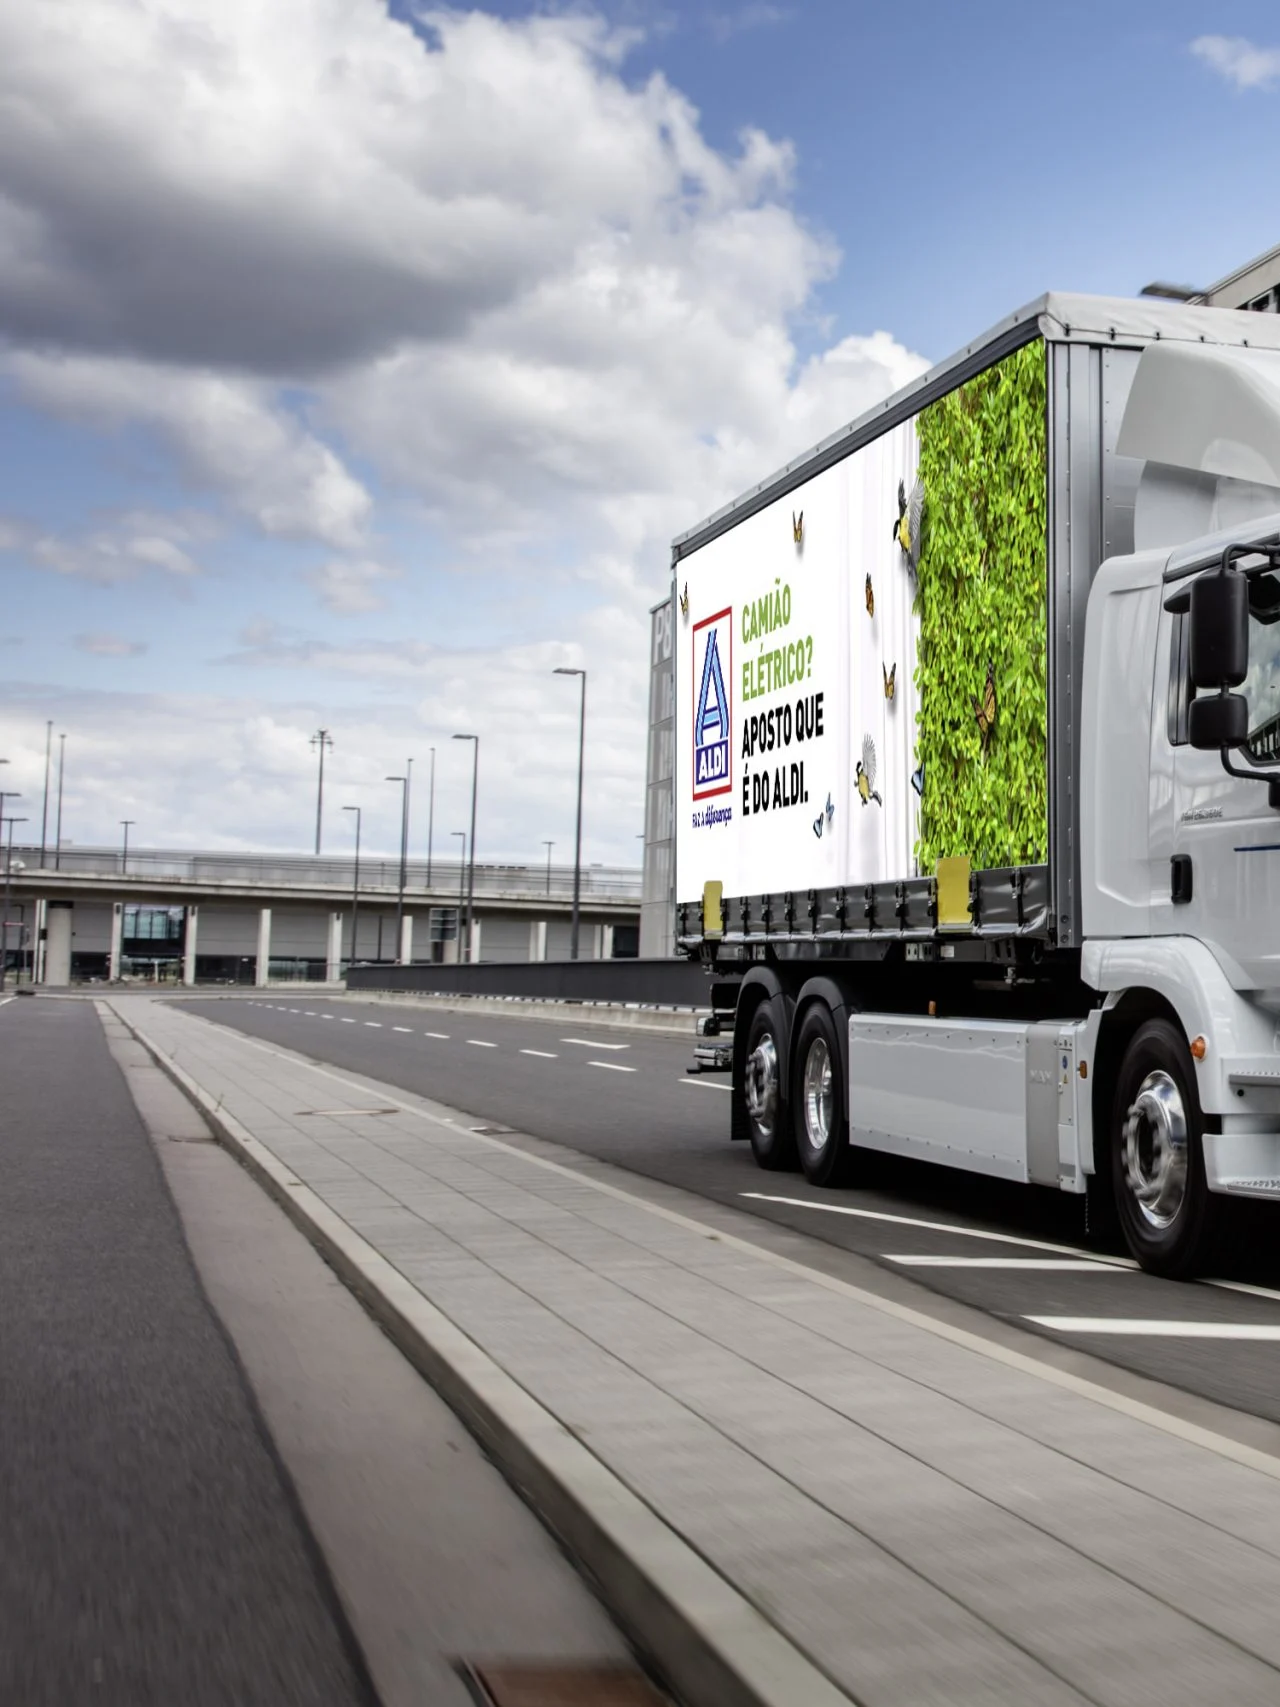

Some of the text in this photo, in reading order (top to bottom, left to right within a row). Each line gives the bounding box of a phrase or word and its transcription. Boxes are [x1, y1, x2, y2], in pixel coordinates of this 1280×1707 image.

[741, 577, 792, 645] CAMIÃO
[742, 641, 814, 702] ELÉTRICO?
[741, 691, 824, 760] APOSTO QUE
[698, 743, 726, 782] ALDI
[742, 759, 809, 817] É DO ALDI.
